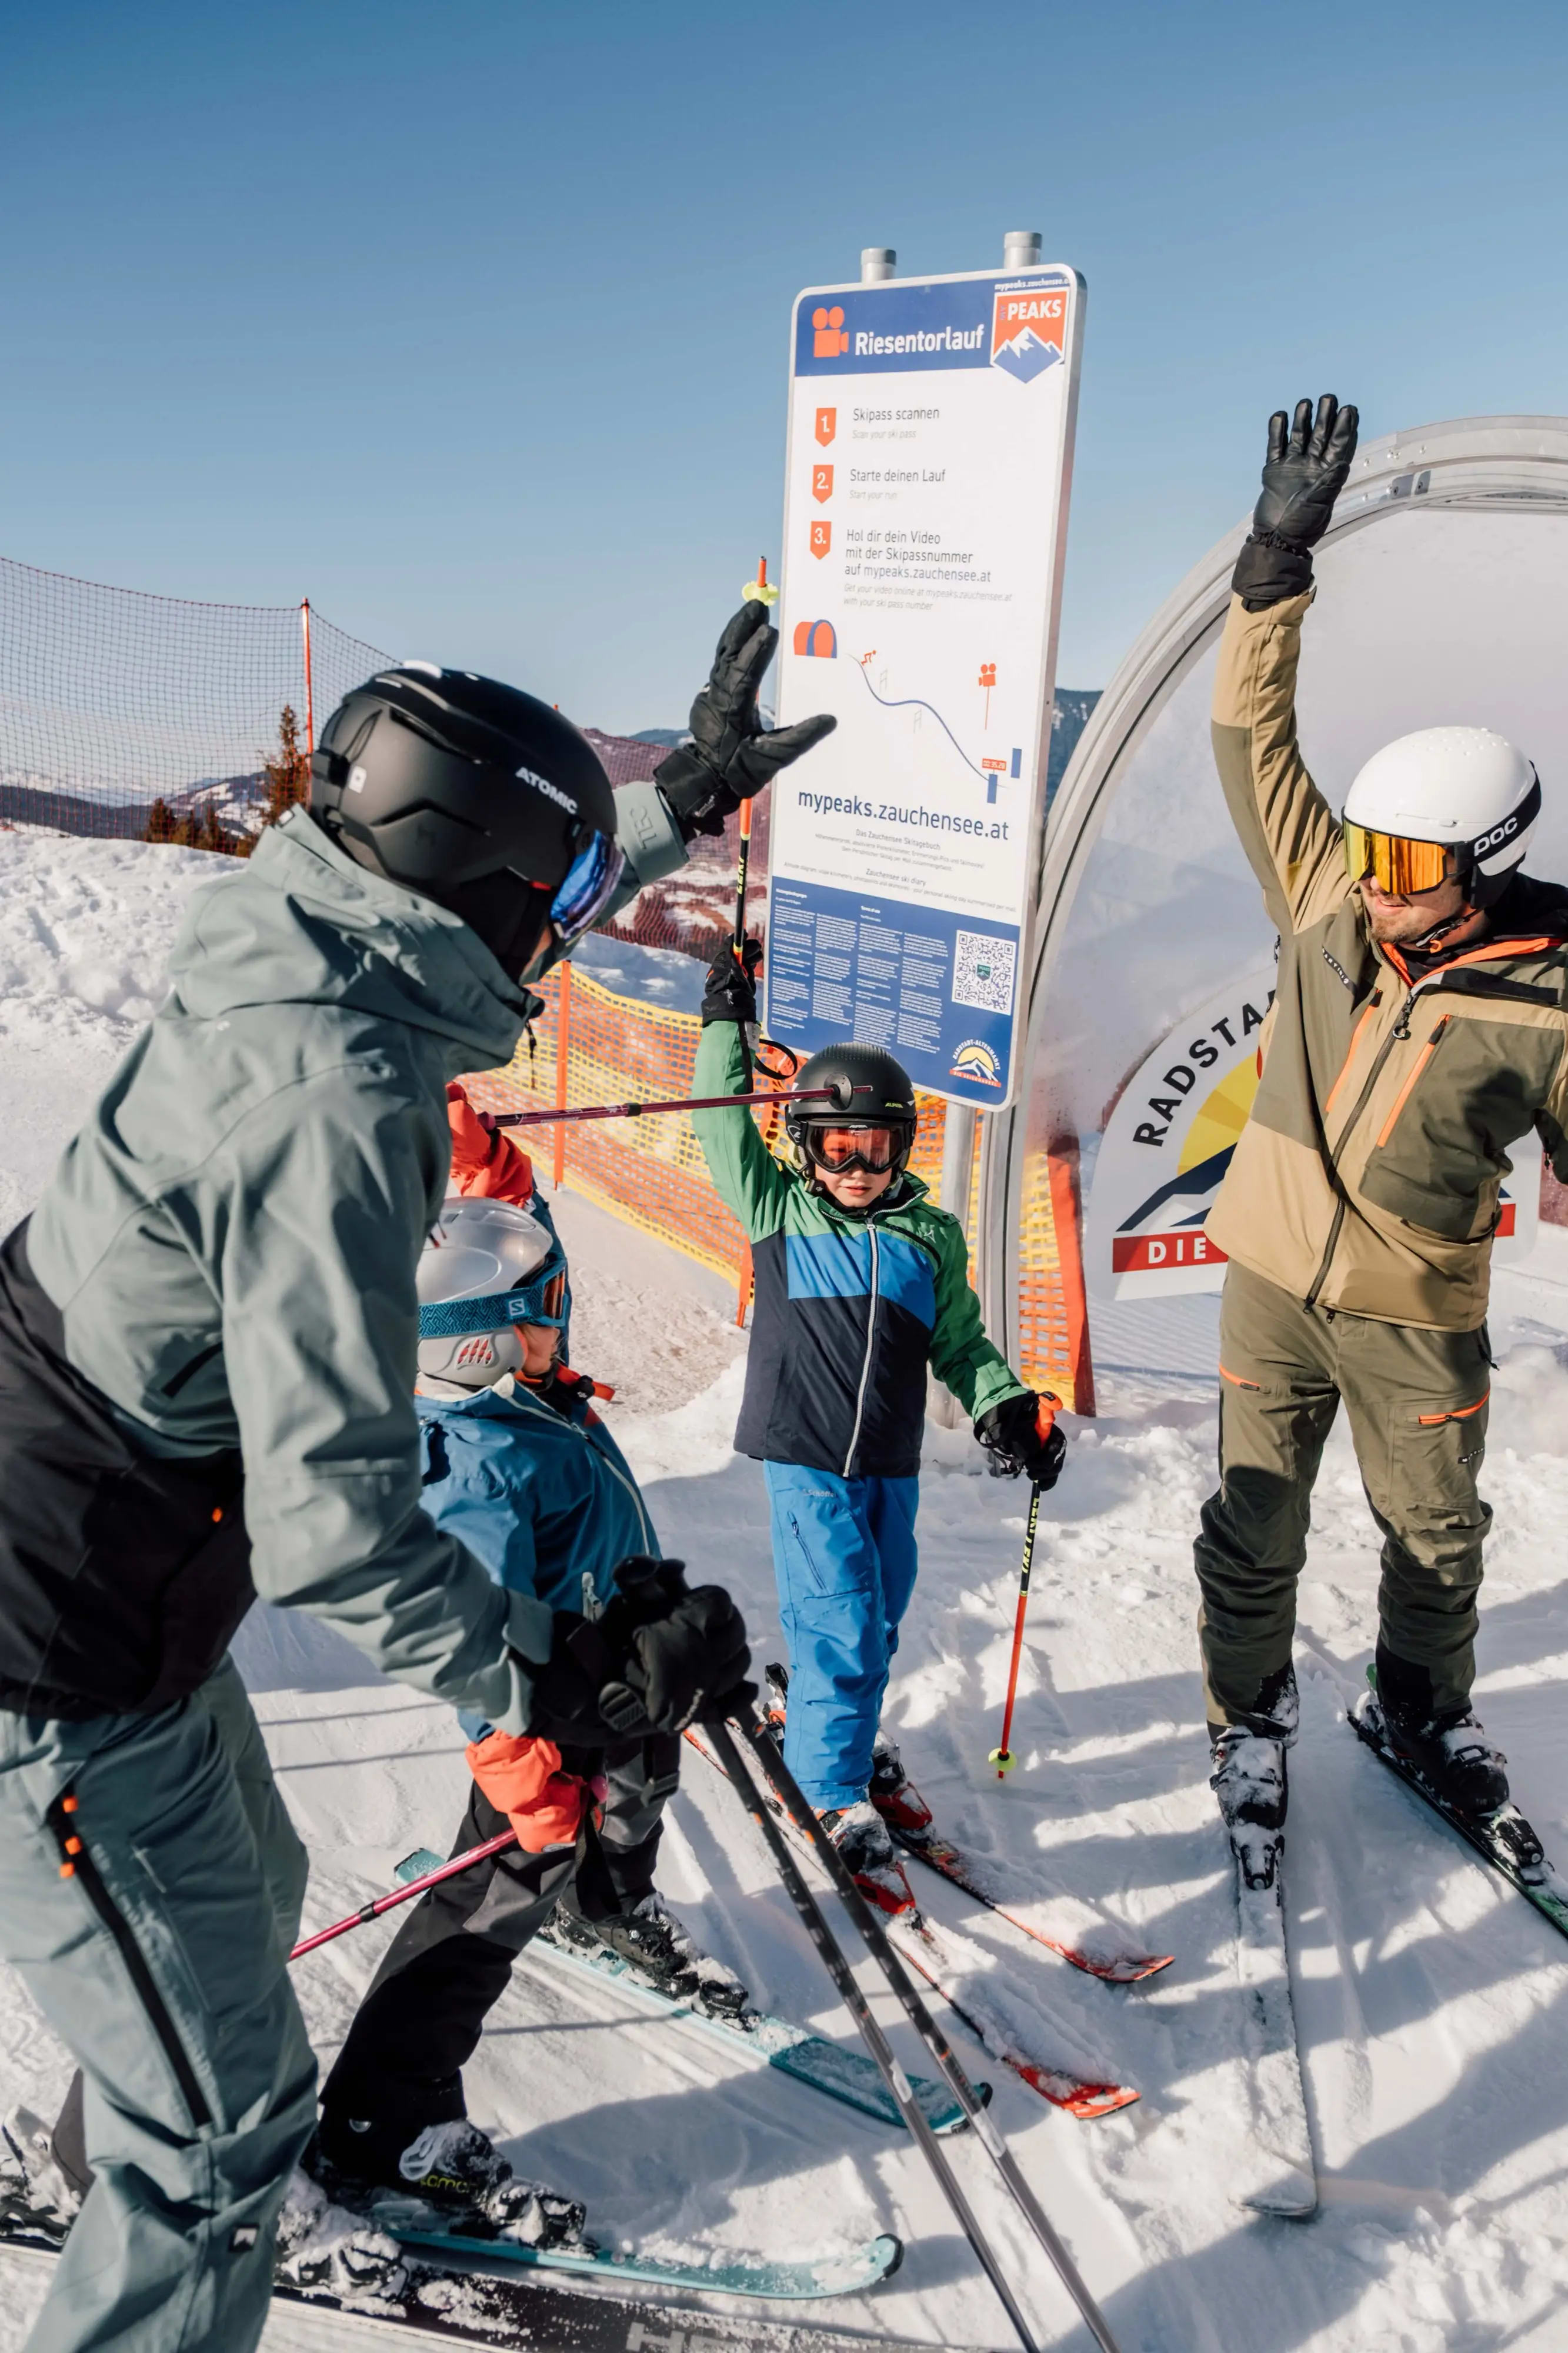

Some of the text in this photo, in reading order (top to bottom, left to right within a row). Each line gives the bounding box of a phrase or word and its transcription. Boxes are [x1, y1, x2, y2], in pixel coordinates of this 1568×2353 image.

[1007, 299, 1062, 321] PEAKS
[855, 324, 985, 355] Riesentorlauf
[820, 415, 830, 433] 1.
[853, 408, 940, 423] Skipass scannen
[852, 429, 869, 439] Scan
[870, 431, 886, 441] your
[899, 431, 916, 441] pass
[816, 471, 829, 490] 2.
[850, 469, 946, 482] Starte deinen Lauf
[849, 490, 866, 499] Start
[814, 527, 827, 545] 3.
[847, 529, 941, 545] Hol dir dein Video
[846, 546, 973, 564] mit der Skipassnummer
[845, 564, 991, 583] auf mypeaks.zauchensee.at
[844, 583, 1012, 602] Get your video online at mypeaks.zauchensee.at
[843, 597, 858, 605] with
[859, 599, 875, 608] your
[888, 600, 903, 610] pass
[906, 601, 933, 611] number
[515, 766, 578, 815] ATOMIC
[798, 791, 1009, 841] mypeaks.zauchensee.at
[856, 829, 941, 851] Das Zauchensee Skitagebuch
[1474, 817, 1518, 856] POC
[866, 868, 899, 881] Zauchensee
[910, 877, 926, 887] diary
[1133, 989, 1276, 1147] RADSTA
[1149, 1237, 1206, 1264] DIE
